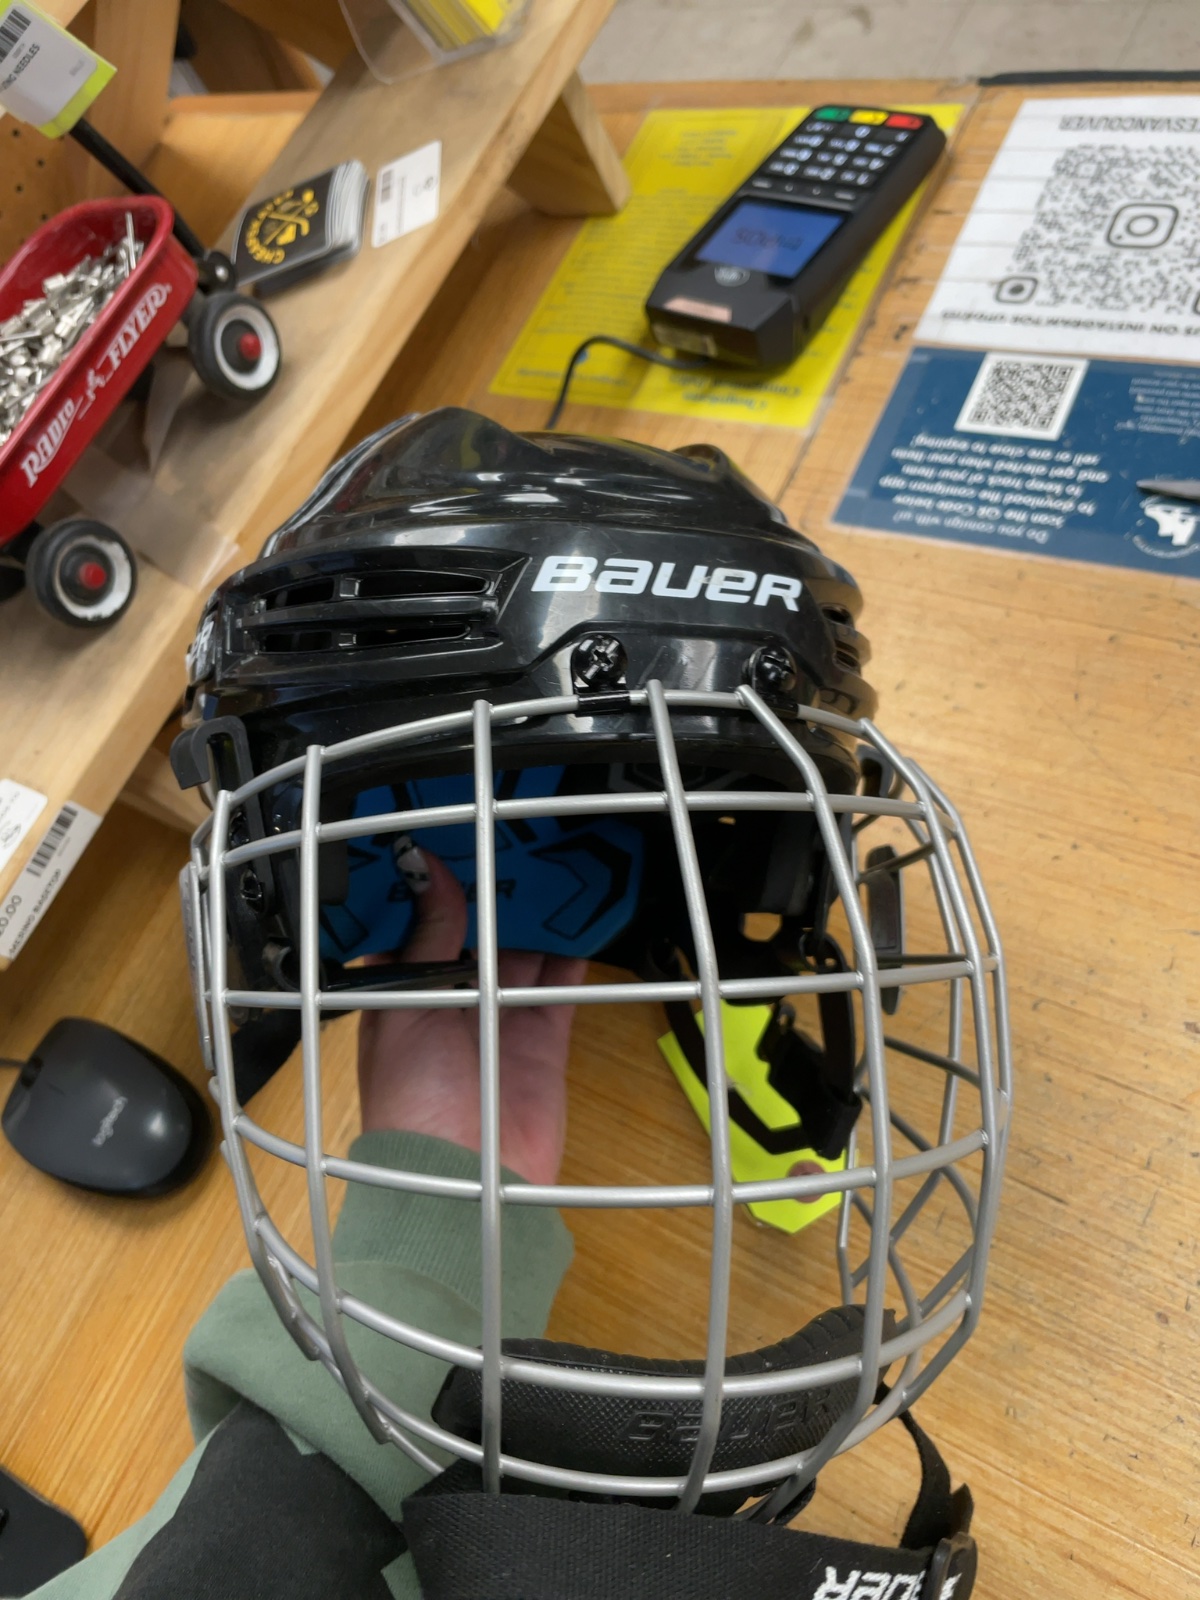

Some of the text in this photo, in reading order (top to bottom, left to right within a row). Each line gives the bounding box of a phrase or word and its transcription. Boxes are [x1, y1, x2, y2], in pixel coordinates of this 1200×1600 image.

[13, 43, 40, 76] NEEDLES
[1059, 115, 1200, 133] ESVANCOUVER
[1044, 317, 1147, 332] INSTAGRAM
[20, 284, 168, 488] RADIO FLYER
[989, 443, 1025, 459] close
[1027, 448, 1051, 461] are
[958, 455, 992, 470] when
[1072, 453, 1101, 466] sell
[993, 459, 1048, 477] alerted
[1049, 465, 1076, 479] get
[1076, 468, 1110, 483] and
[879, 475, 907, 490] app
[987, 473, 1024, 490] track
[1025, 477, 1064, 496] keep
[978, 488, 1001, 502] the
[1065, 484, 1084, 498] to
[893, 493, 933, 509] below
[936, 501, 975, 516] Code
[1002, 492, 1075, 513] download
[976, 506, 1000, 520] QR
[1003, 508, 1028, 523] the
[1077, 502, 1097, 516] to
[914, 512, 941, 526] with
[944, 517, 995, 534] consign
[998, 524, 1025, 538] you
[1026, 528, 1048, 544] Do
[812, 1566, 962, 1600] UER
